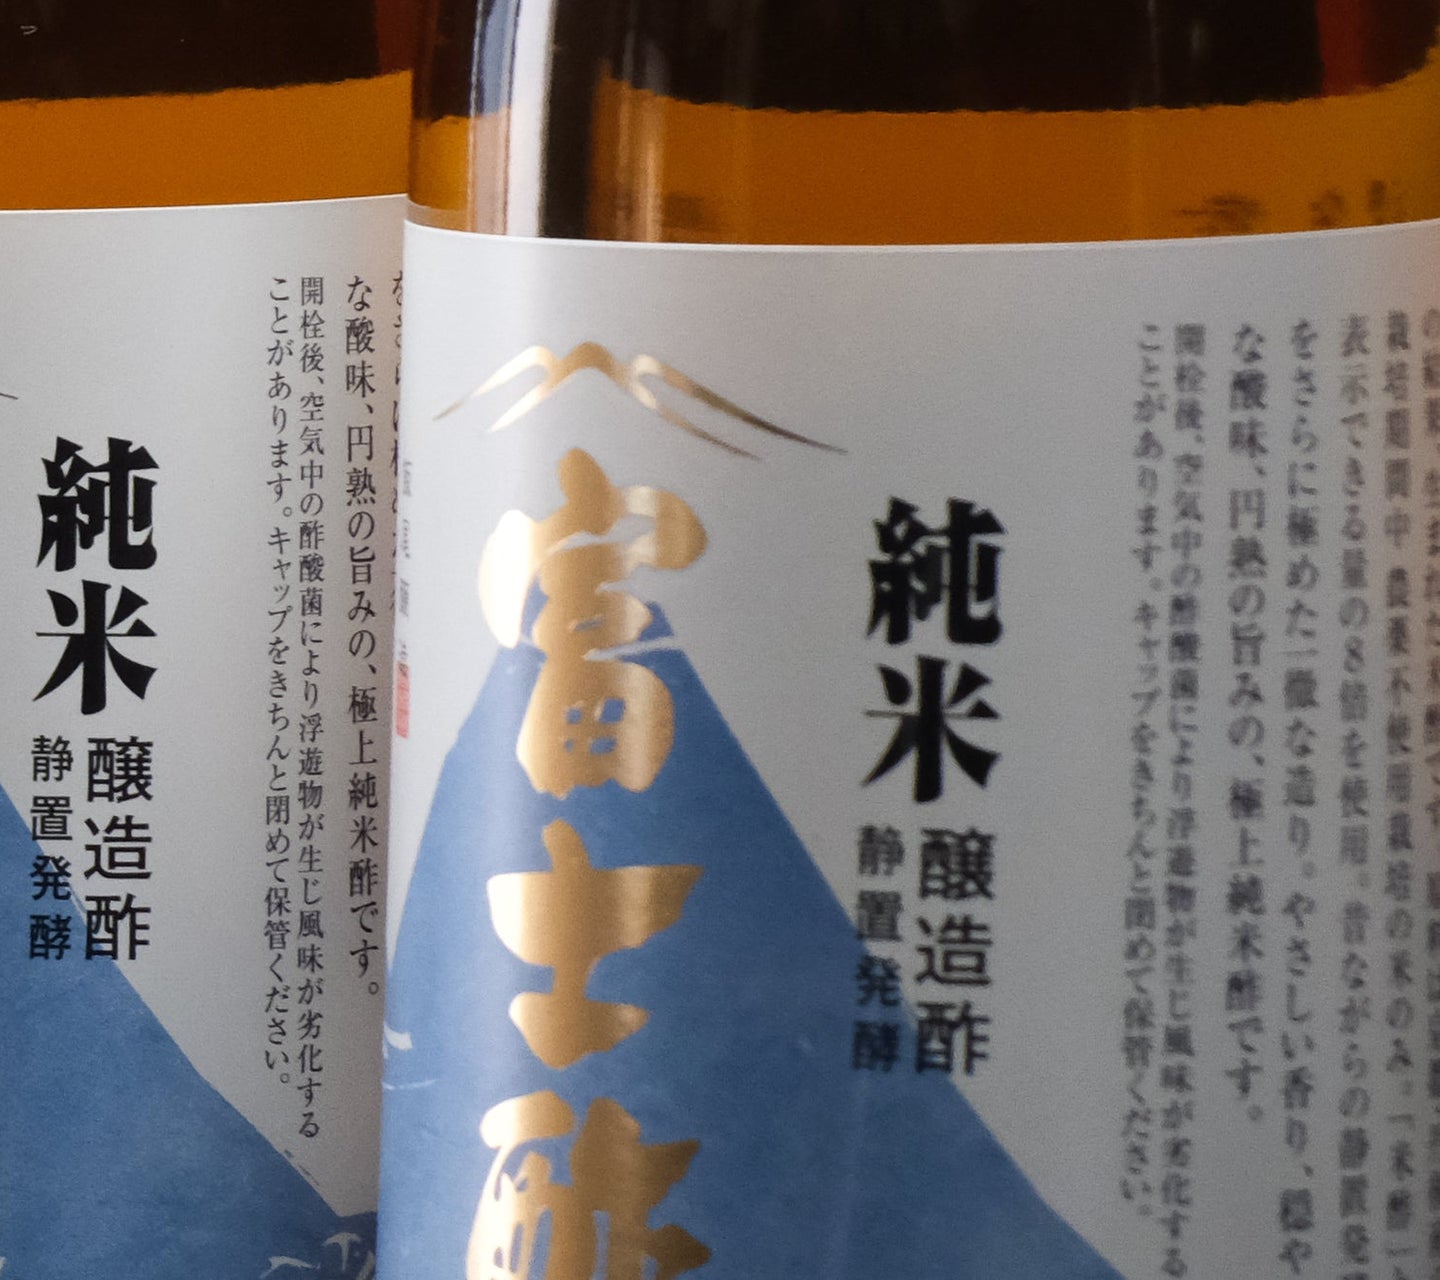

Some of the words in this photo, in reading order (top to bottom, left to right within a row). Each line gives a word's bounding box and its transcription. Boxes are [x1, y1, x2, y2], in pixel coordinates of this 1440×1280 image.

[35, 436, 158, 717] 純米
[264, 276, 294, 1085] ことがあります。キャップをきちんと閉めて保管ください。
[297, 275, 326, 1138] 開栓後、空気中の酢酸菌により浮遊物が生じ風味が劣化する
[344, 275, 380, 997] な酸味、円熟の旨みの、極上純米酢です。
[866, 495, 1005, 805] 純米
[1224, 322, 1268, 1120] な酸味、円熟の旨みの、極上純米酢です。
[30, 734, 73, 962] 静置発酵
[83, 734, 155, 963] 醸造酢
[853, 824, 906, 1076] 静置発酵
[915, 825, 997, 1078] 醸造酢
